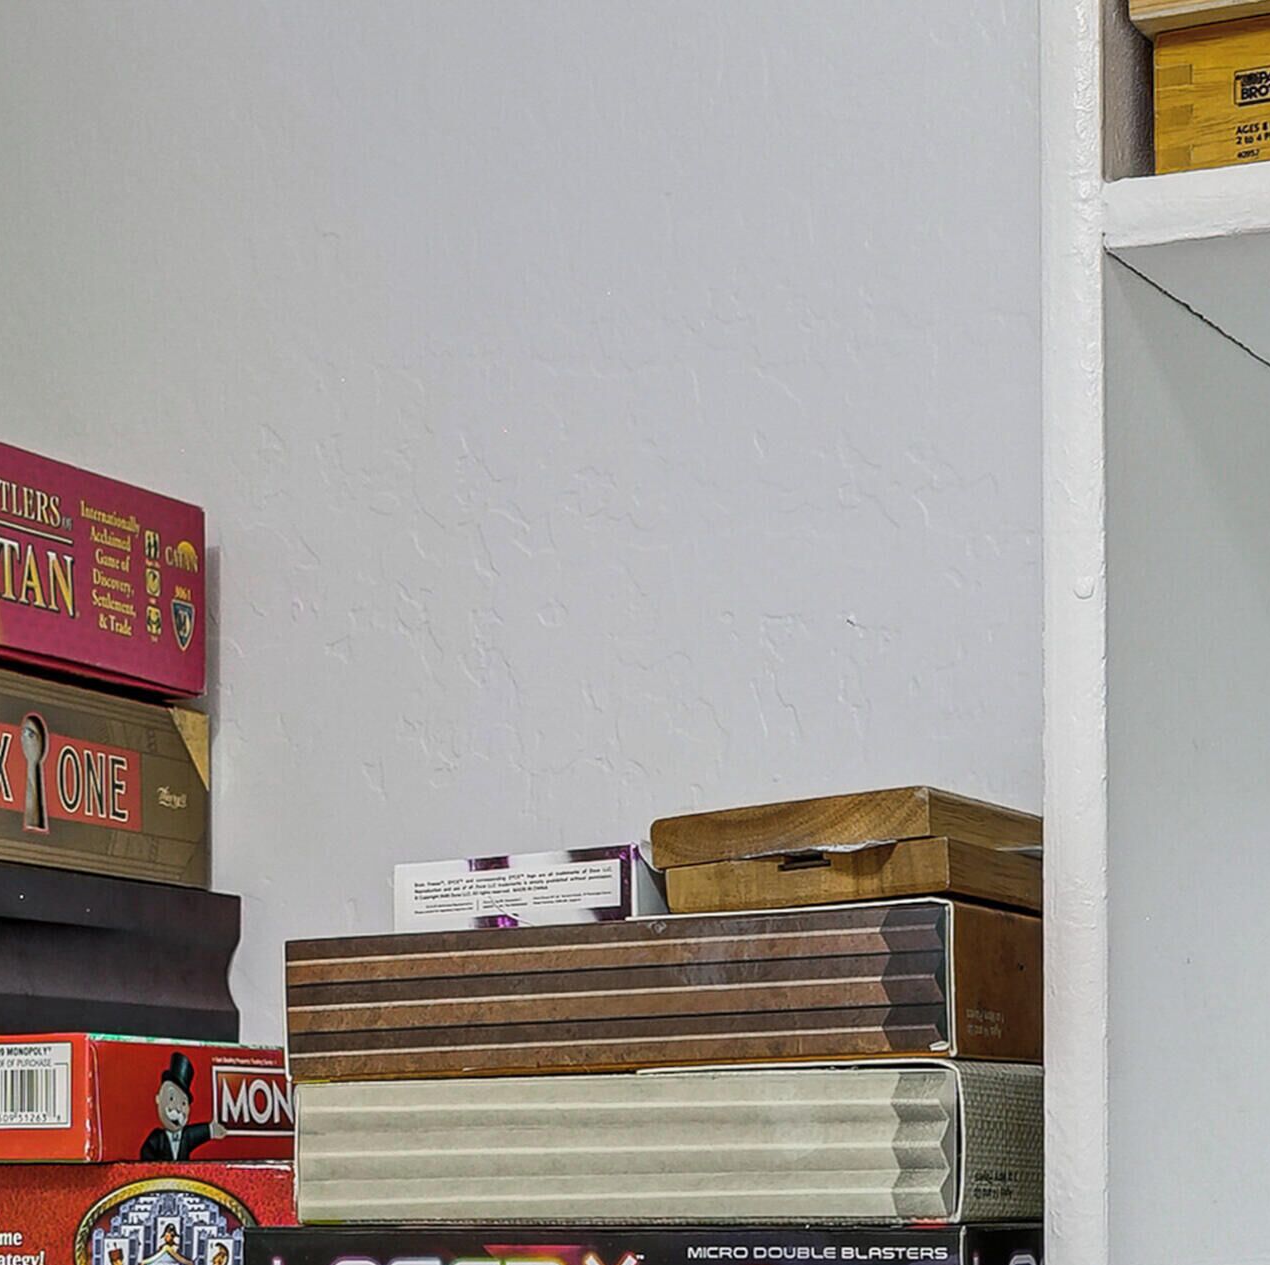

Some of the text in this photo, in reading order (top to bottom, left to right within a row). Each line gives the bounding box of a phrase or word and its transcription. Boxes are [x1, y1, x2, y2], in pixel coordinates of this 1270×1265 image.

[1235, 136, 1242, 145] 2
[1244, 135, 1254, 144] to
[1256, 133, 1262, 141] 4
[81, 500, 140, 538] Internationally
[90, 525, 131, 552] Acclaimed
[95, 548, 120, 570] Game
[121, 555, 130, 572] of
[109, 615, 132, 636] Trade
[57, 745, 129, 822] ONE
[7, 1059, 15, 1068] OF
[17, 1058, 52, 1067] PURCHASE
[687, 1246, 949, 1261] MICRO DOUBLE BLASTERS
